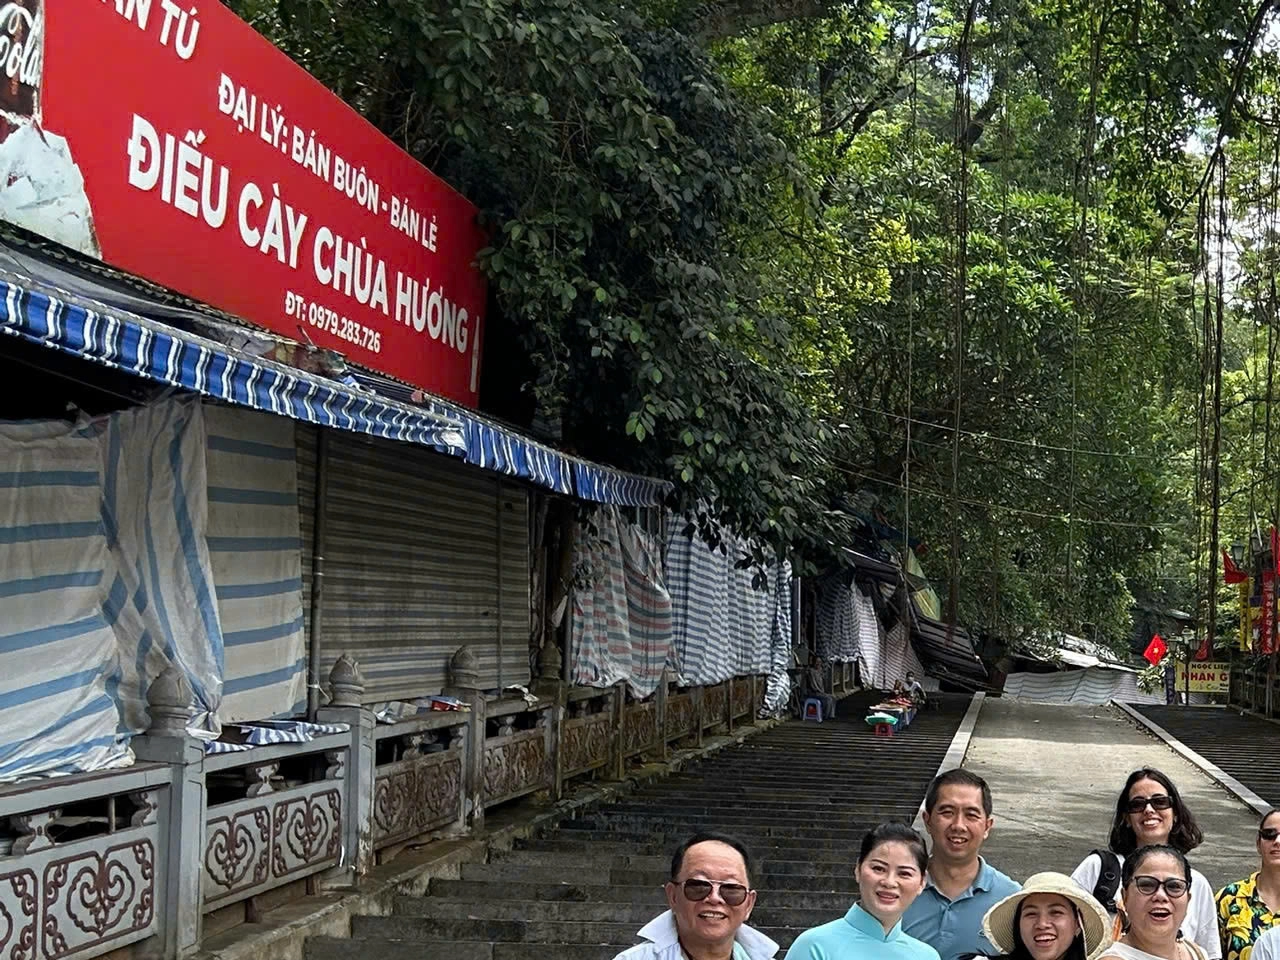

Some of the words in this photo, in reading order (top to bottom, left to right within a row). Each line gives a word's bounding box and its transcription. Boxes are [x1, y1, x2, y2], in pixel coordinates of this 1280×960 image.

[160, 0, 200, 60] TÚ
[218, 72, 256, 133] ĐẠI
[260, 103, 288, 154] LÝ:
[291, 125, 331, 182] BÁN
[333, 154, 380, 215] BUÔN
[390, 195, 420, 241] BÁN
[421, 215, 438, 253] LẺ
[238, 182, 308, 270] CÀY
[313, 226, 389, 316] CHÙA
[395, 271, 468, 353] HƯƠNG
[285, 290, 307, 321] ĐT:
[308, 302, 381, 353] 0979.283.726
